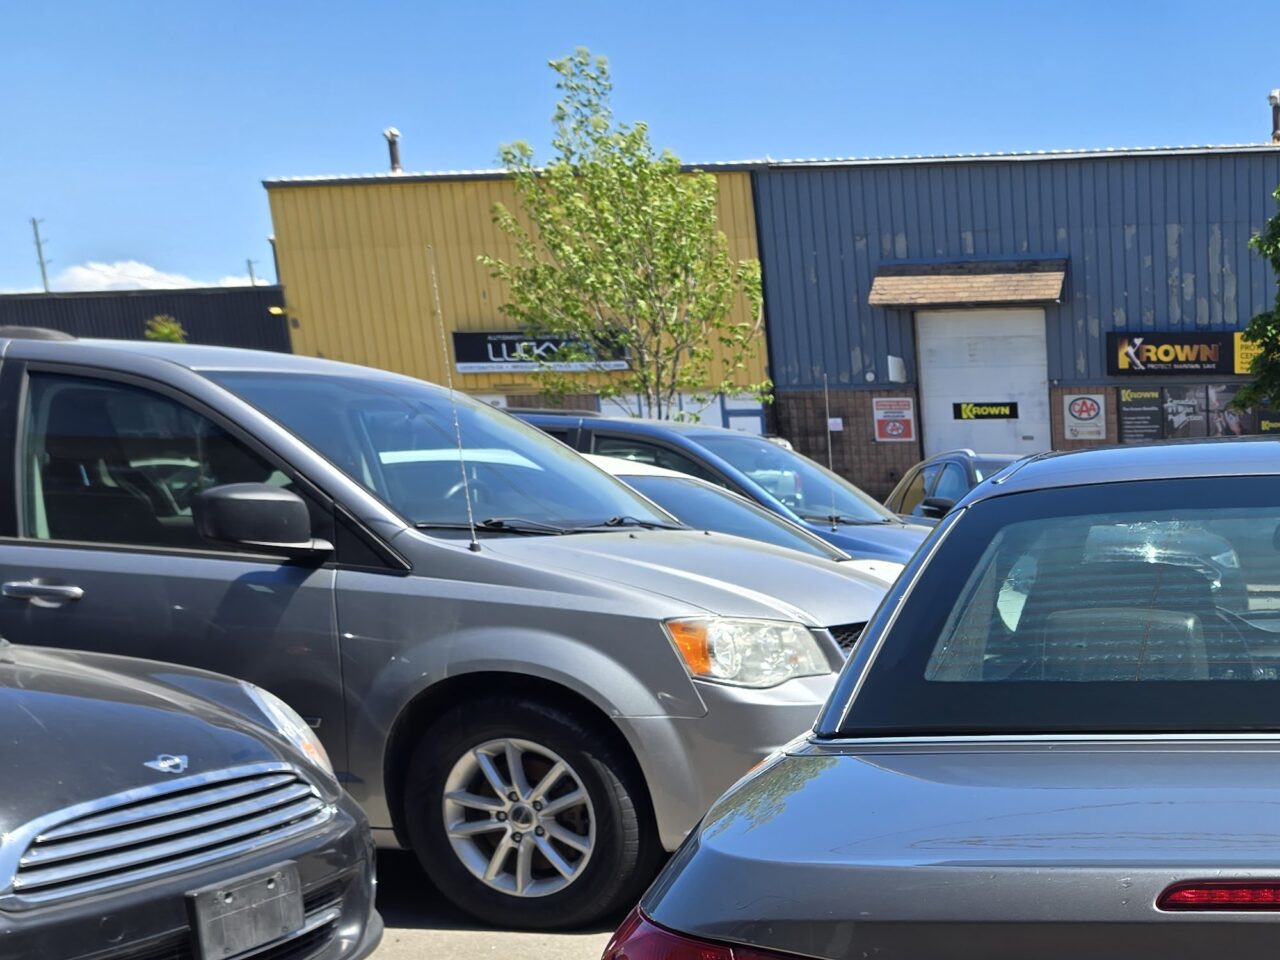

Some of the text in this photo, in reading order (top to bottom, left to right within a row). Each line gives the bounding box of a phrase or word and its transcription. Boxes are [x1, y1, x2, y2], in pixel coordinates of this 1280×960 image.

[1118, 337, 1219, 370] KROWN
[1121, 389, 1159, 402] KROWN
[961, 403, 1010, 419] KROWN
[1072, 400, 1097, 416] CAA
